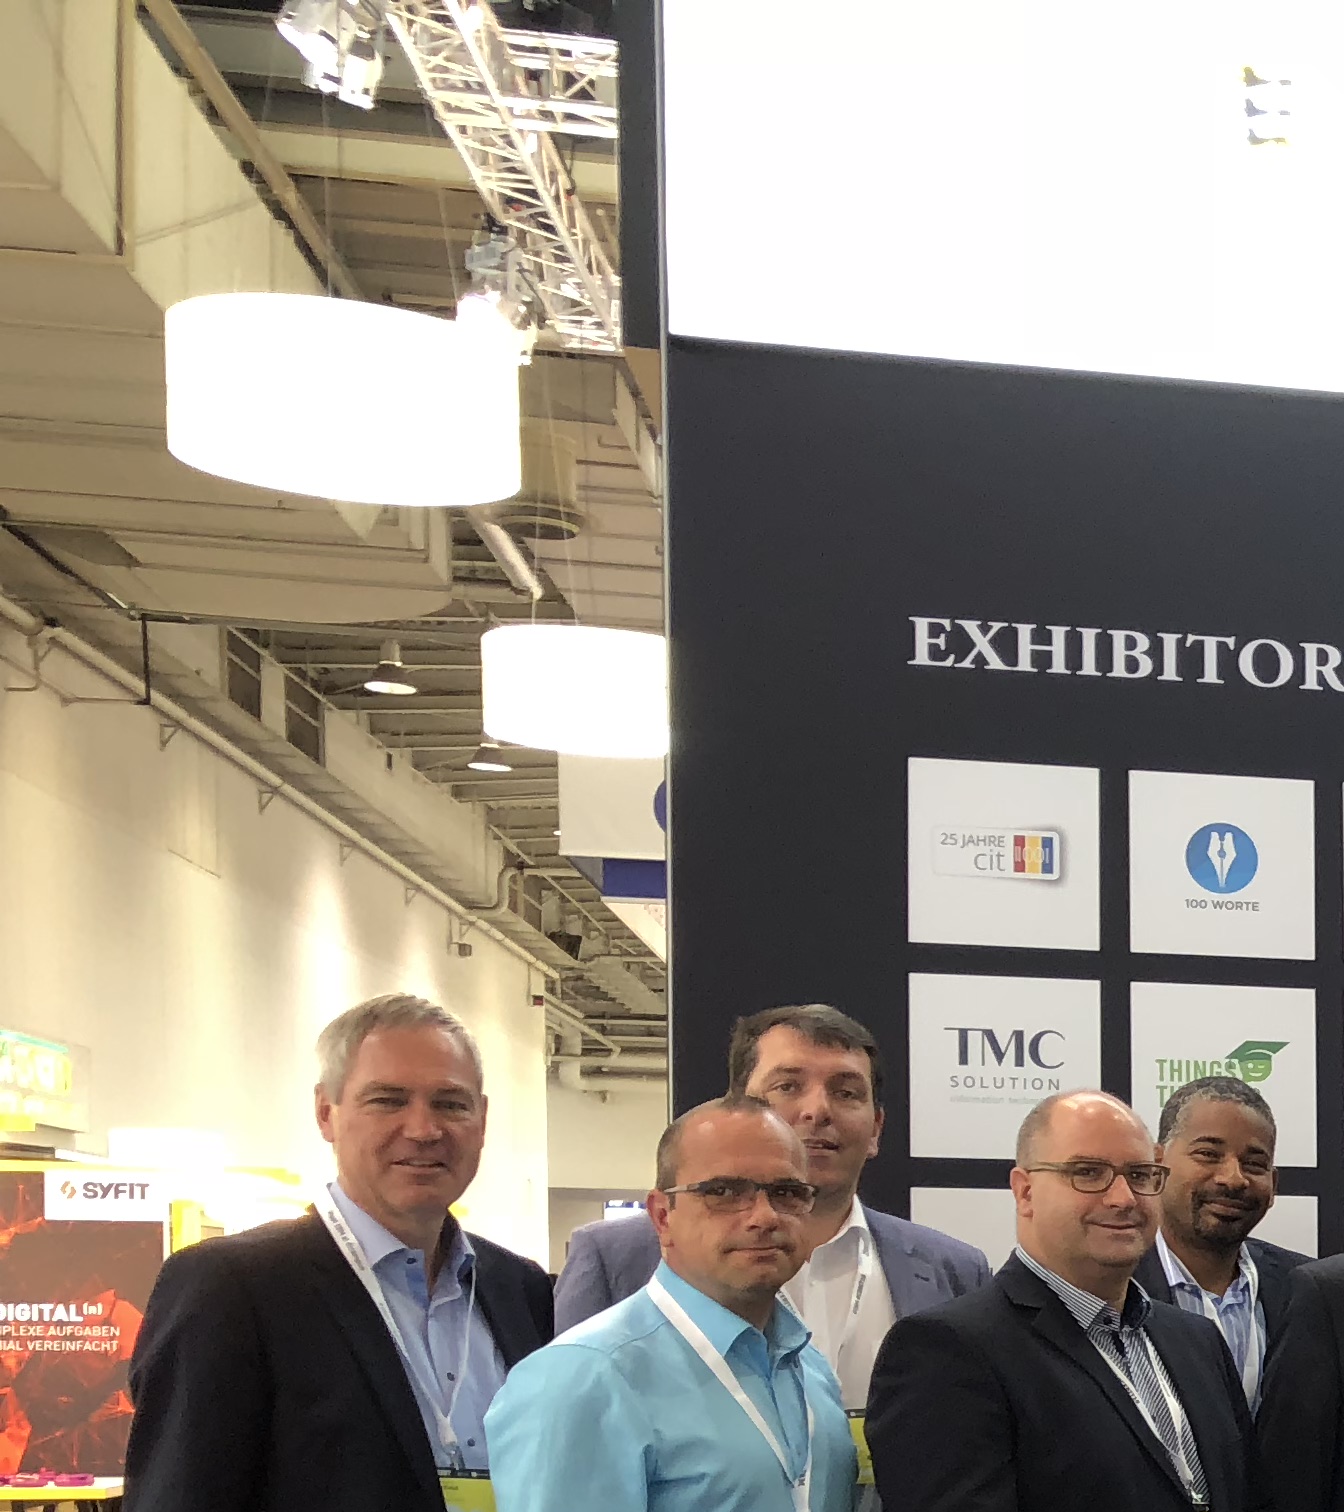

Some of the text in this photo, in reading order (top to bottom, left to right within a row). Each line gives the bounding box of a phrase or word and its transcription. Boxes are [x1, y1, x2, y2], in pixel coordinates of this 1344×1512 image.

[940, 832, 1006, 848] 25 JAHRE
[973, 849, 1006, 872] cit
[1185, 898, 1260, 912] 100 WORTE
[944, 1027, 1066, 1070] TMC
[1155, 1058, 1238, 1082] THINGS
[949, 1075, 1061, 1091] SOLUTION
[82, 1181, 150, 1200] SYFIT
[48, 1325, 121, 1338] AUFGABEN
[27, 1339, 120, 1352] VEREINFACHT
